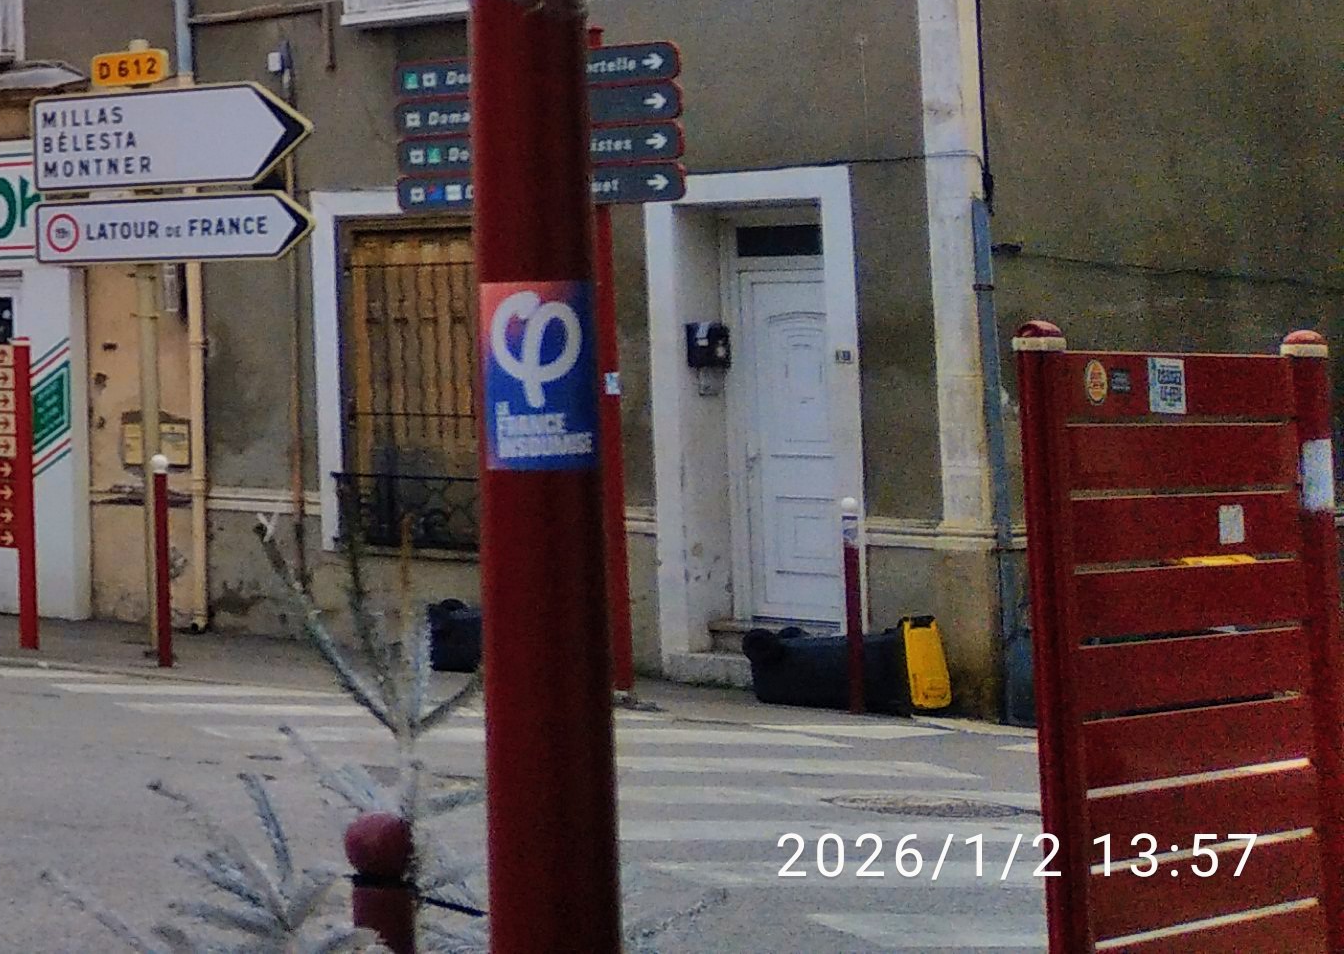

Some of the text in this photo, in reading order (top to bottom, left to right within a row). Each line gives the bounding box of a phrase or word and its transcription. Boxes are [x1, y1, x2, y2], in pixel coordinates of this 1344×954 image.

[98, 58, 158, 80] D 612
[42, 106, 123, 128] MILLAS
[43, 130, 137, 154] BÉLESTA
[43, 156, 152, 178] MONTNER
[86, 220, 159, 241] LATOUR
[188, 216, 268, 236] FRANCE
